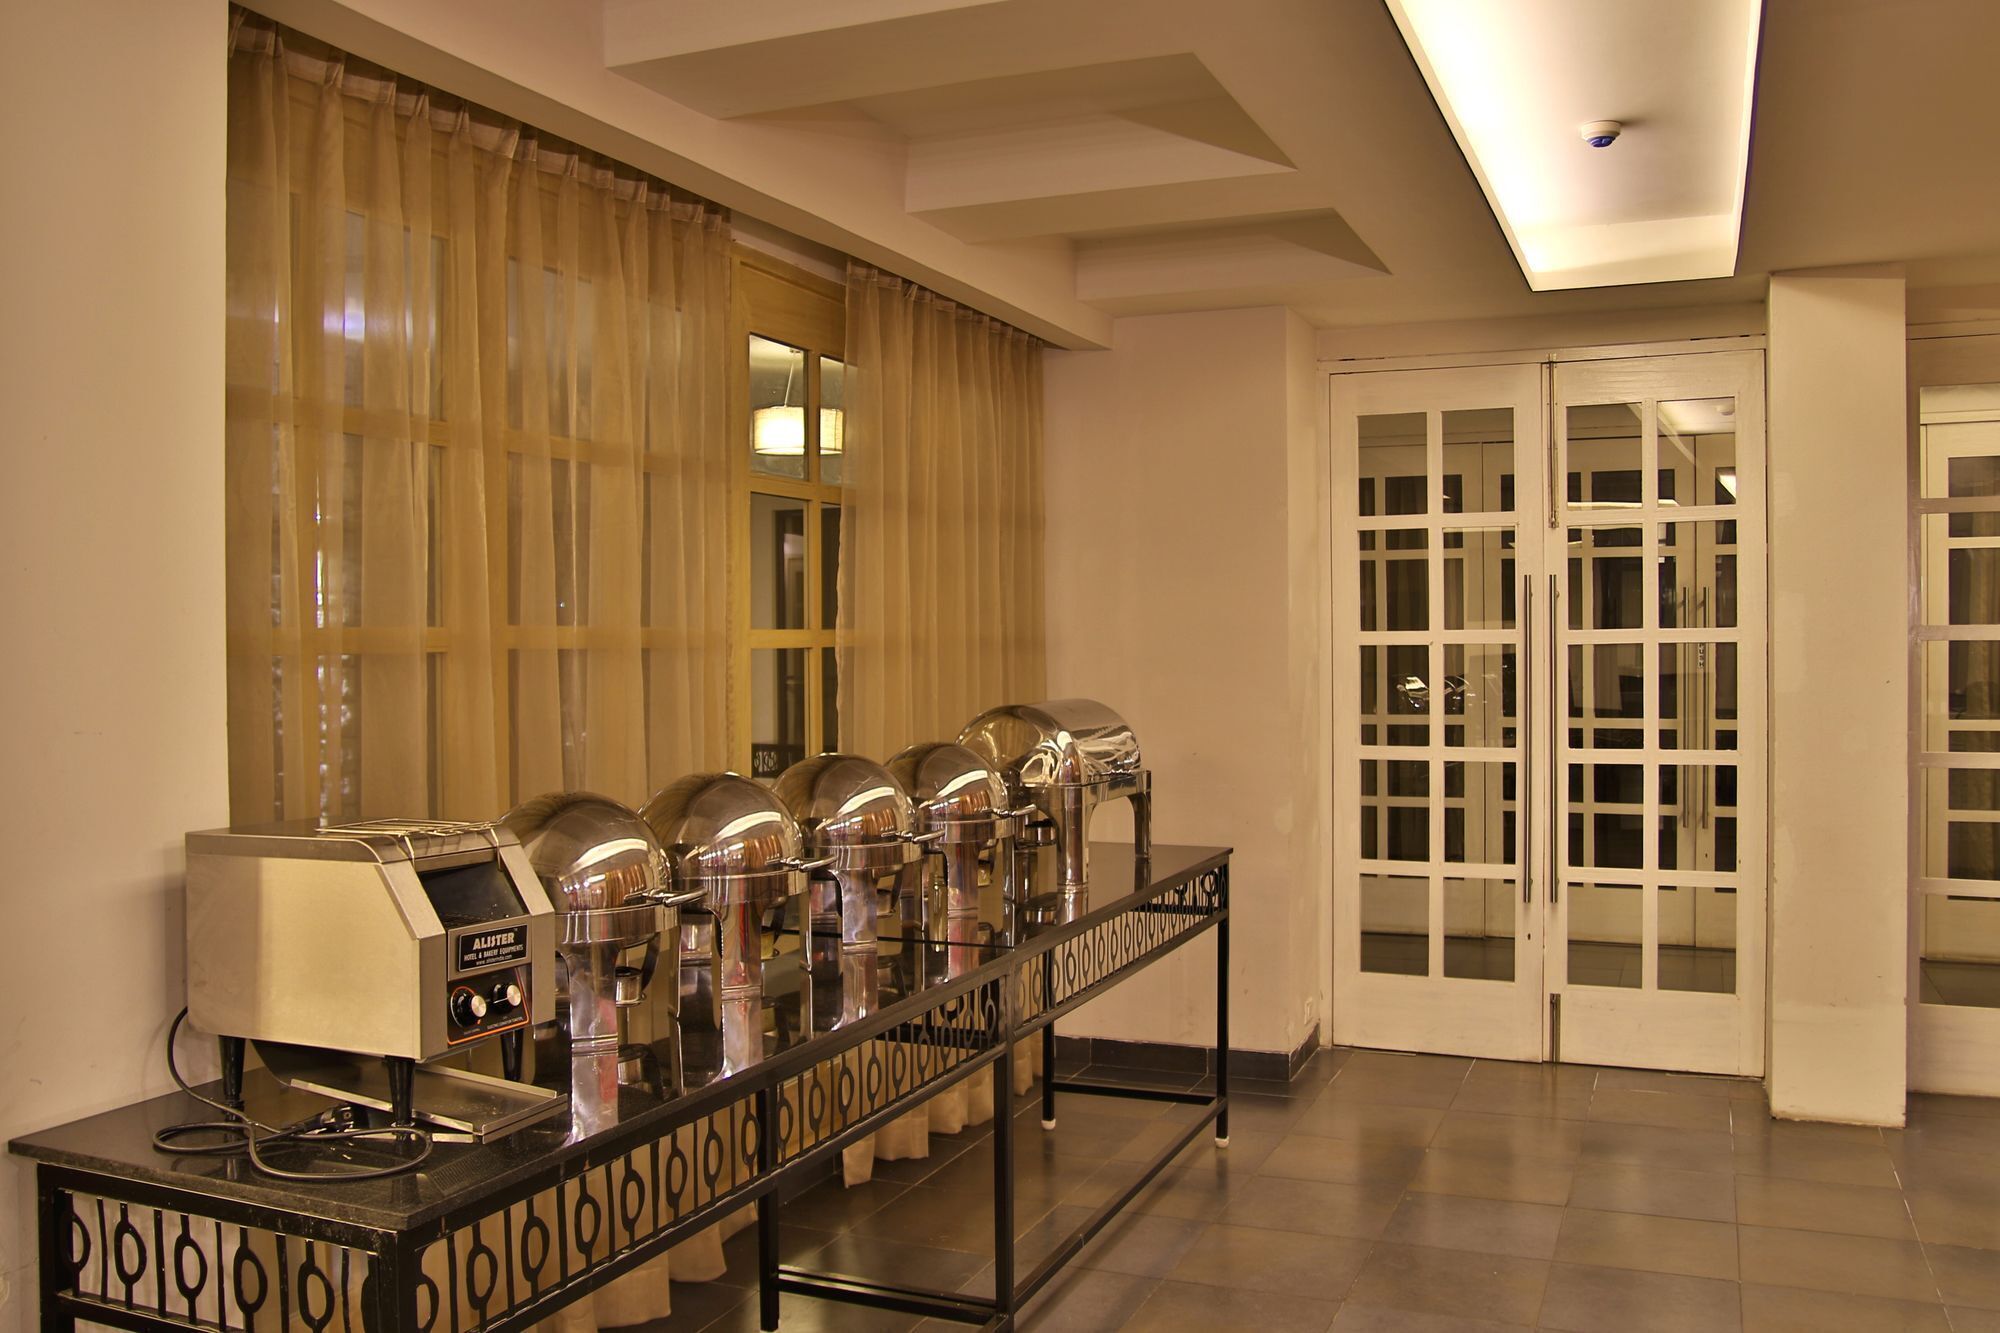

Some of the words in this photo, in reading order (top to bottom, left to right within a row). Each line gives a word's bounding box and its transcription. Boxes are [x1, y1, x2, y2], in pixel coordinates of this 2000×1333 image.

[473, 932, 515, 950] ALISTER
[464, 953, 477, 962] HOTEL
[483, 949, 499, 958] BAKERY
[500, 944, 523, 955] EQUIPMENTS
